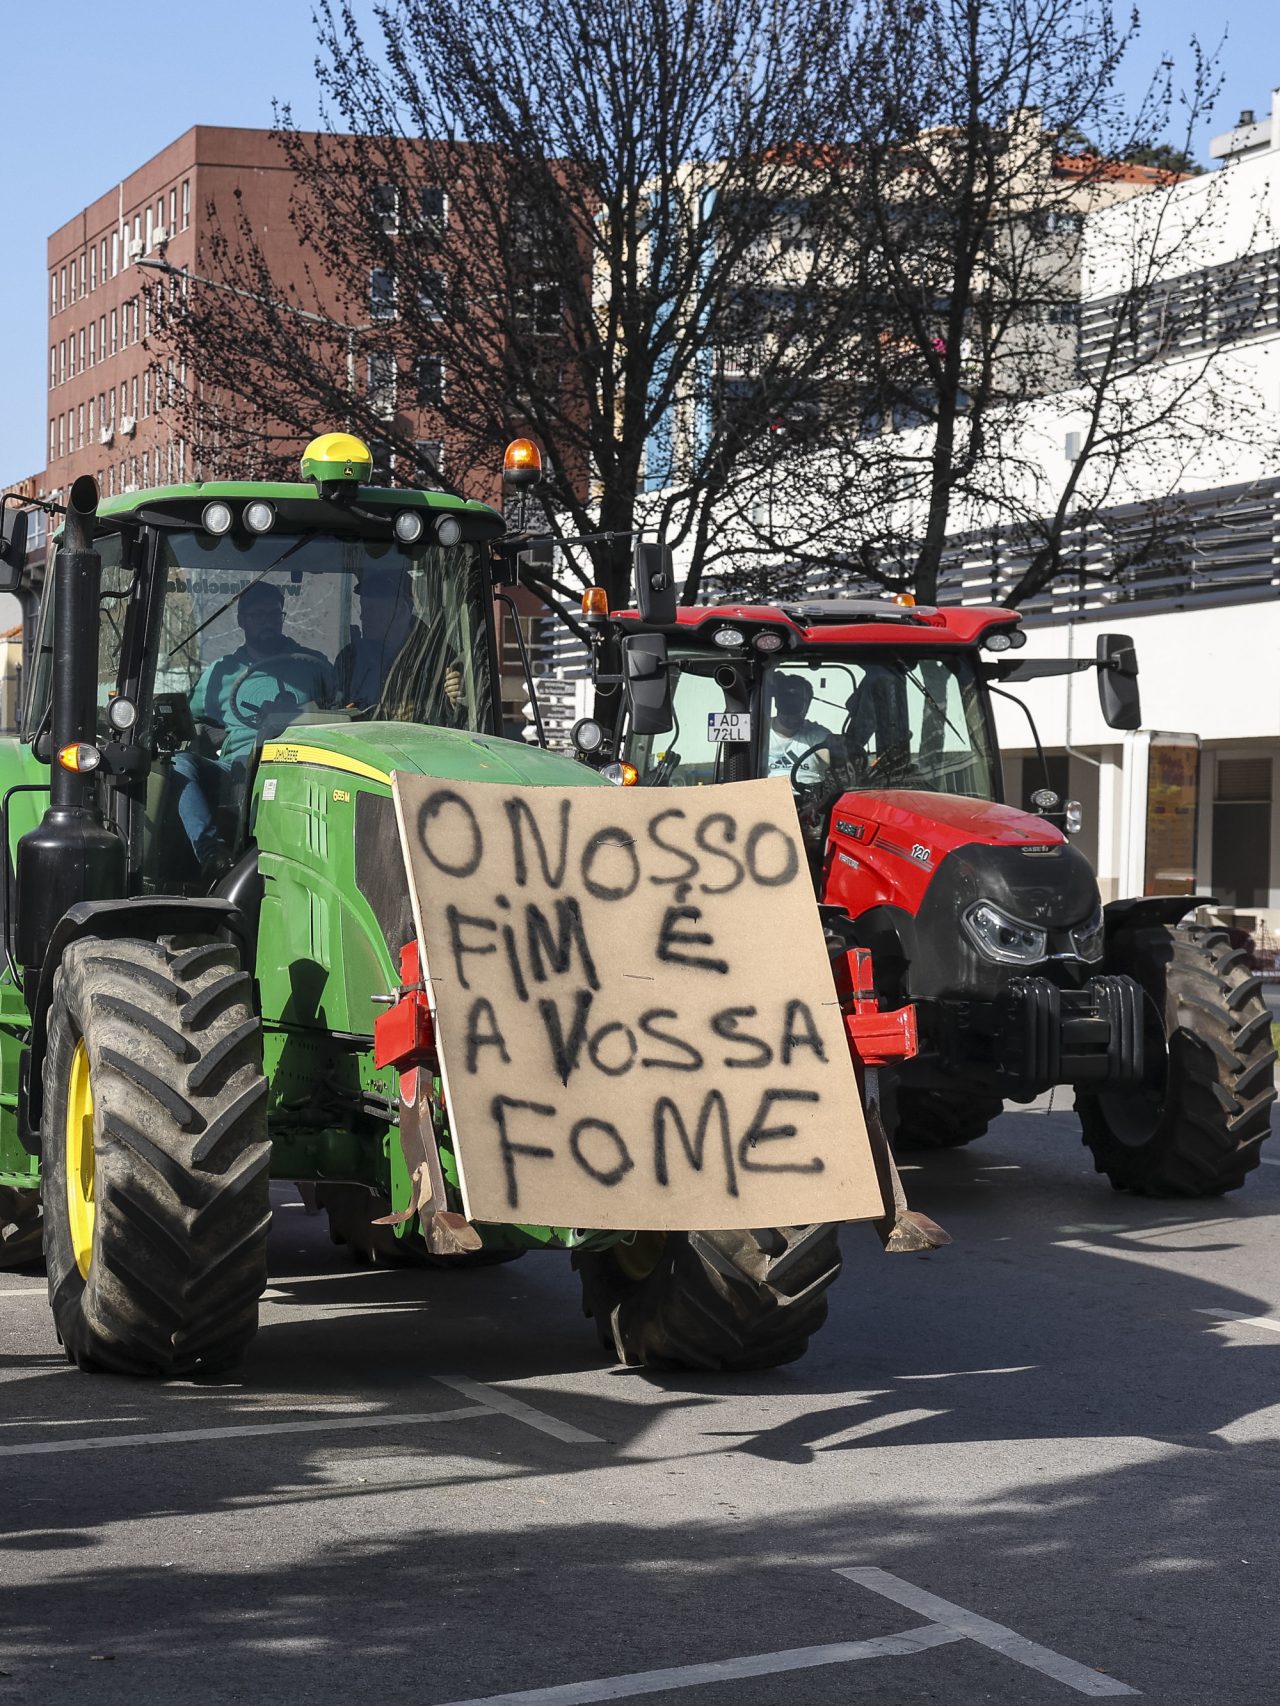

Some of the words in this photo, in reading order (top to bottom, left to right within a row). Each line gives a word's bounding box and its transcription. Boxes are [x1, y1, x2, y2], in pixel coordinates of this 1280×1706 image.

[720, 714, 739, 727] AD
[420, 790, 483, 878] O
[505, 798, 798, 900] NOSSO
[911, 844, 931, 861] 120
[656, 883, 729, 974] É
[466, 998, 511, 1075] A
[540, 990, 828, 1087] VOSSA
[492, 1089, 824, 1208] FOME
